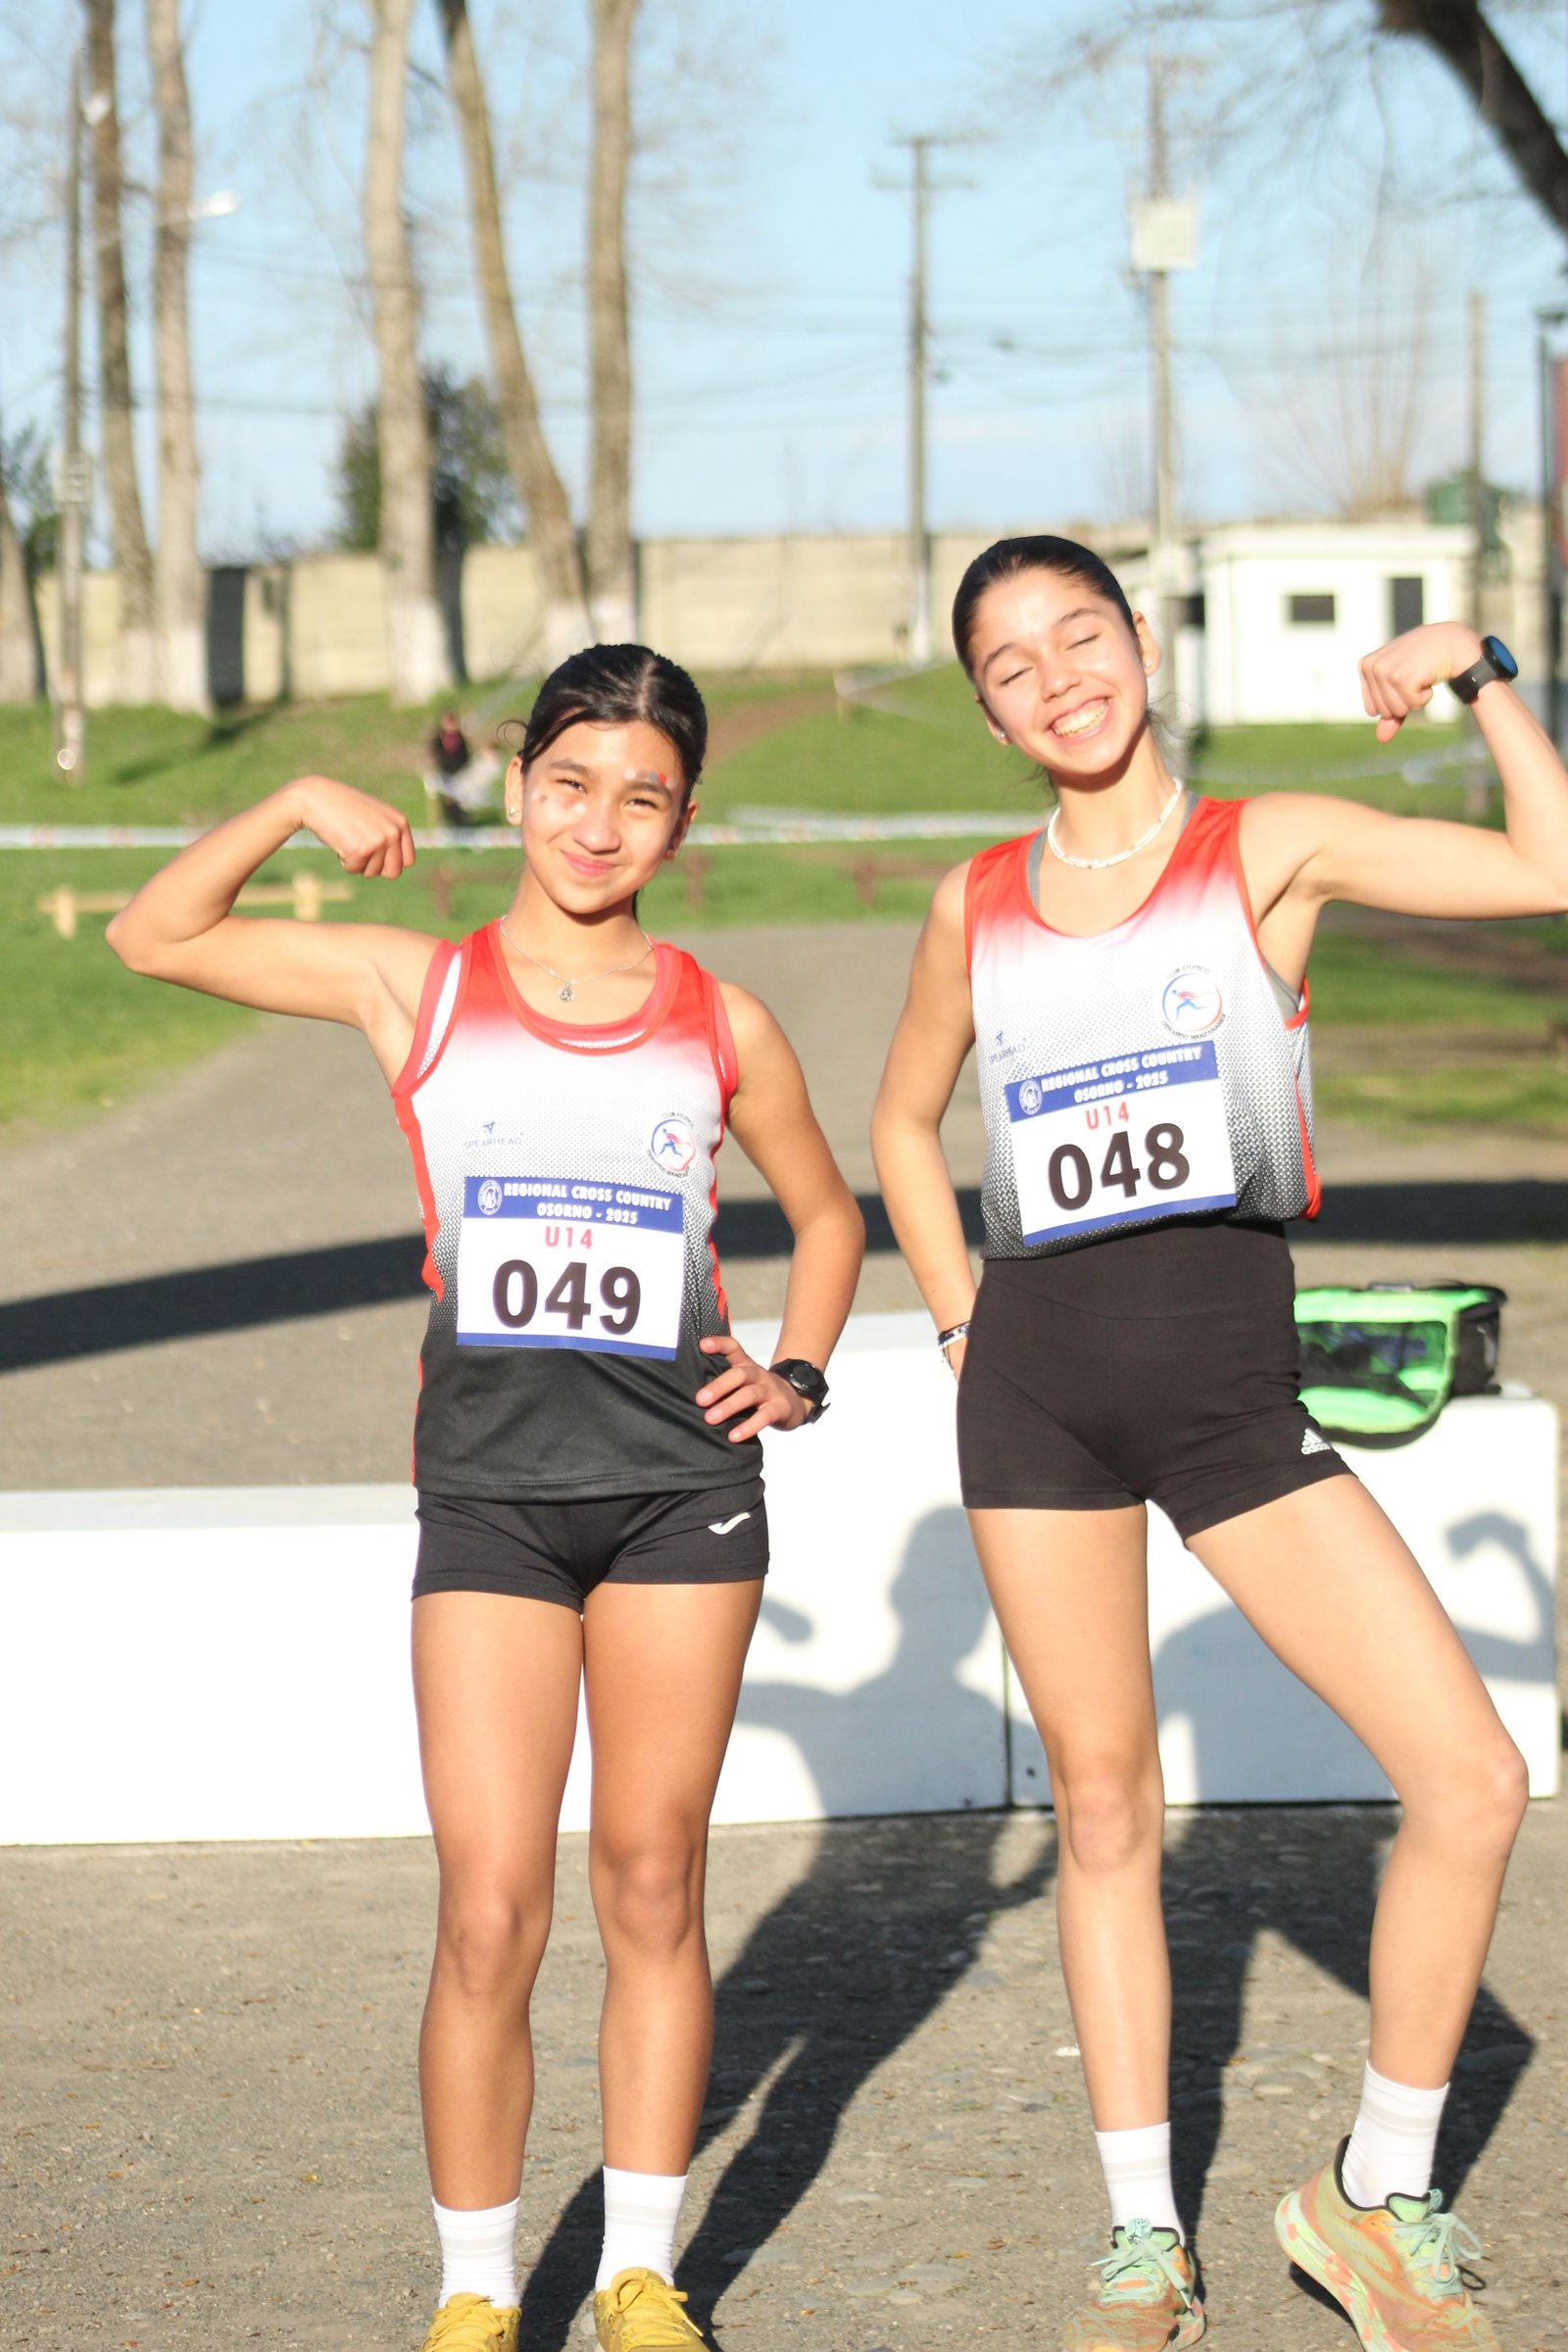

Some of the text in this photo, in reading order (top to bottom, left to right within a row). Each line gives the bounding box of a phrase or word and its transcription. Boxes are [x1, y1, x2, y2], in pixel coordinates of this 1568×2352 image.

[1041, 1046, 1203, 1093] REGIONAL CROSS COUNTRY
[1074, 1080, 1124, 1103] OSORNO
[1135, 1070, 1169, 1091] 2025
[1085, 1102, 1130, 1130] U14
[464, 1136, 522, 1150] SPEARHEAD
[1048, 1122, 1191, 1211] 048
[503, 1182, 568, 1199] REGIONAL
[571, 1185, 612, 1202] CROSS
[615, 1190, 672, 1212] COUNTRY
[536, 1202, 593, 1220] OSORNO
[606, 1207, 638, 1225] 2025
[545, 1225, 593, 1250] U14
[492, 1258, 642, 1336] 049
